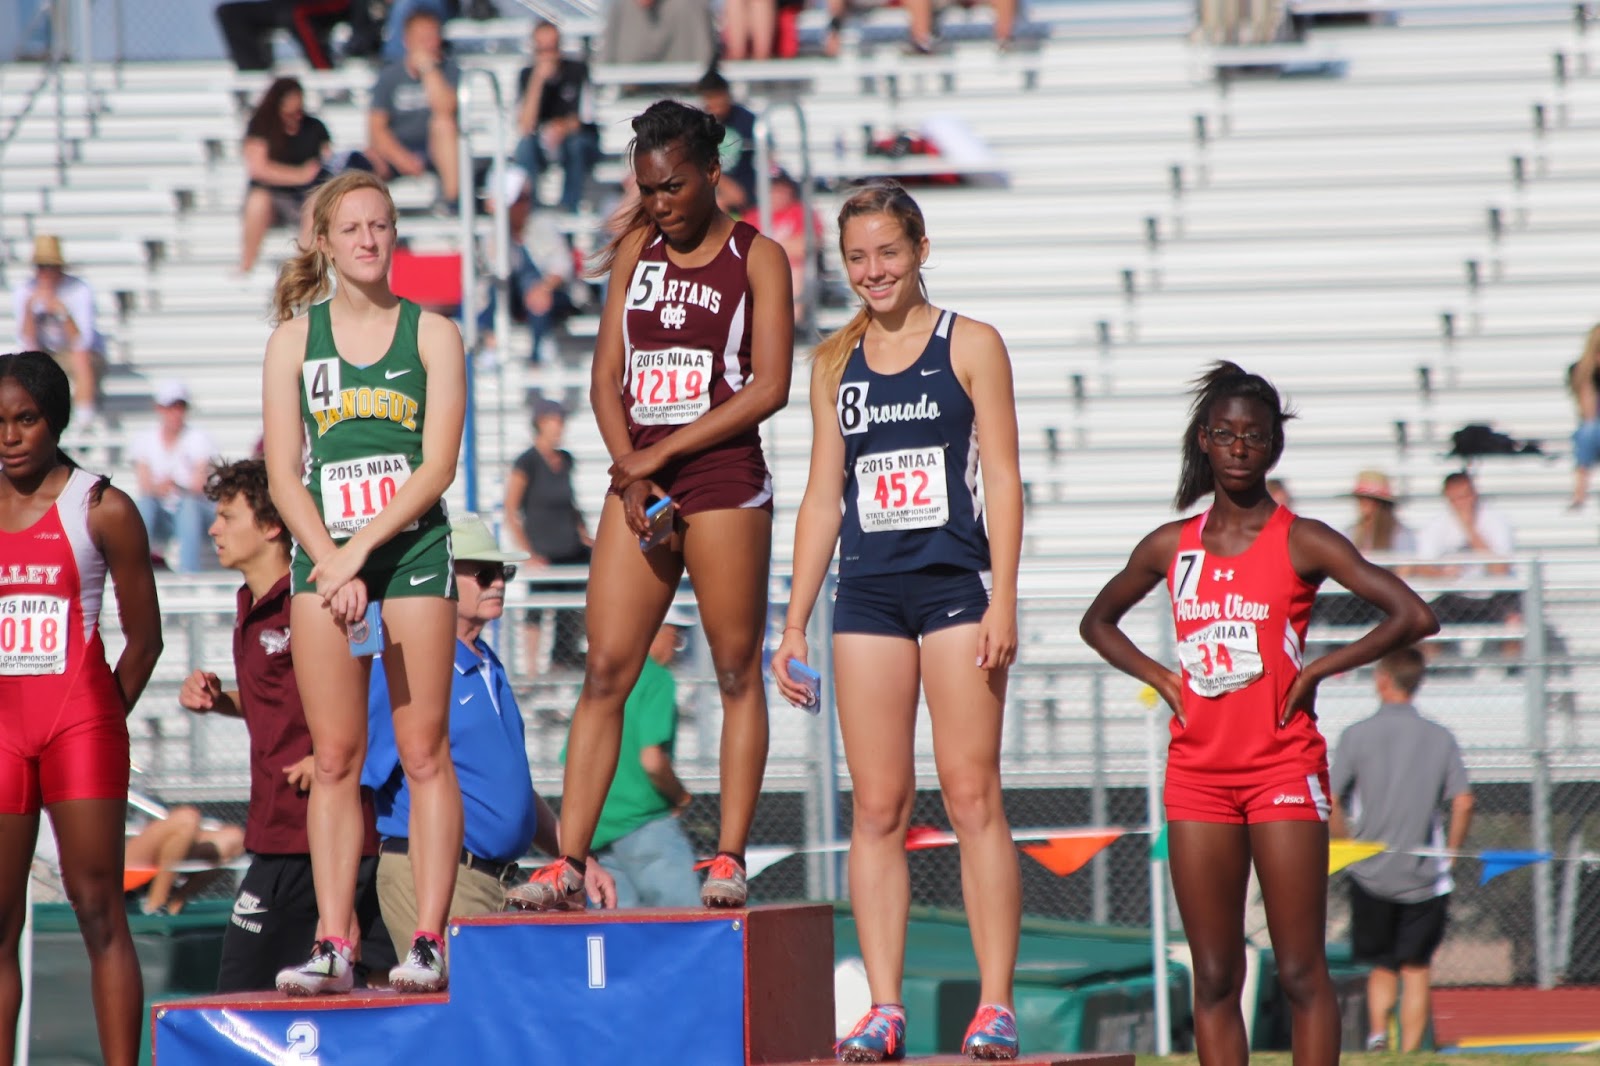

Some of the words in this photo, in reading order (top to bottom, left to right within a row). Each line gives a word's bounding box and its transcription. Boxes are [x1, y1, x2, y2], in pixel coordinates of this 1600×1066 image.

[633, 265, 660, 306] 5
[637, 353, 664, 367] 2015
[667, 352, 705, 367] NIAA
[310, 363, 334, 407] 4
[636, 369, 703, 404] 1219
[650, 402, 703, 412] CHAMPIONSHIP
[841, 386, 861, 431] 8
[328, 465, 363, 481] 2015
[367, 459, 404, 477] NIAA
[861, 457, 894, 474] 2015
[898, 453, 937, 469] NIAA
[339, 476, 398, 518] 110
[874, 470, 931, 509] 452
[332, 520, 353, 529] STATE
[866, 512, 885, 520] STATE
[886, 507, 941, 518] CHAMPIONSHIP
[1178, 554, 1198, 598] 7
[22, 600, 60, 614] NIAA
[1177, 595, 1221, 622] Arbor
[1225, 593, 1270, 620] View
[1213, 626, 1249, 639] NIAA
[4, 655, 58, 663] CHAMPIONSHIP
[1197, 643, 1233, 677] 34
[239, 891, 261, 909] NIKE
